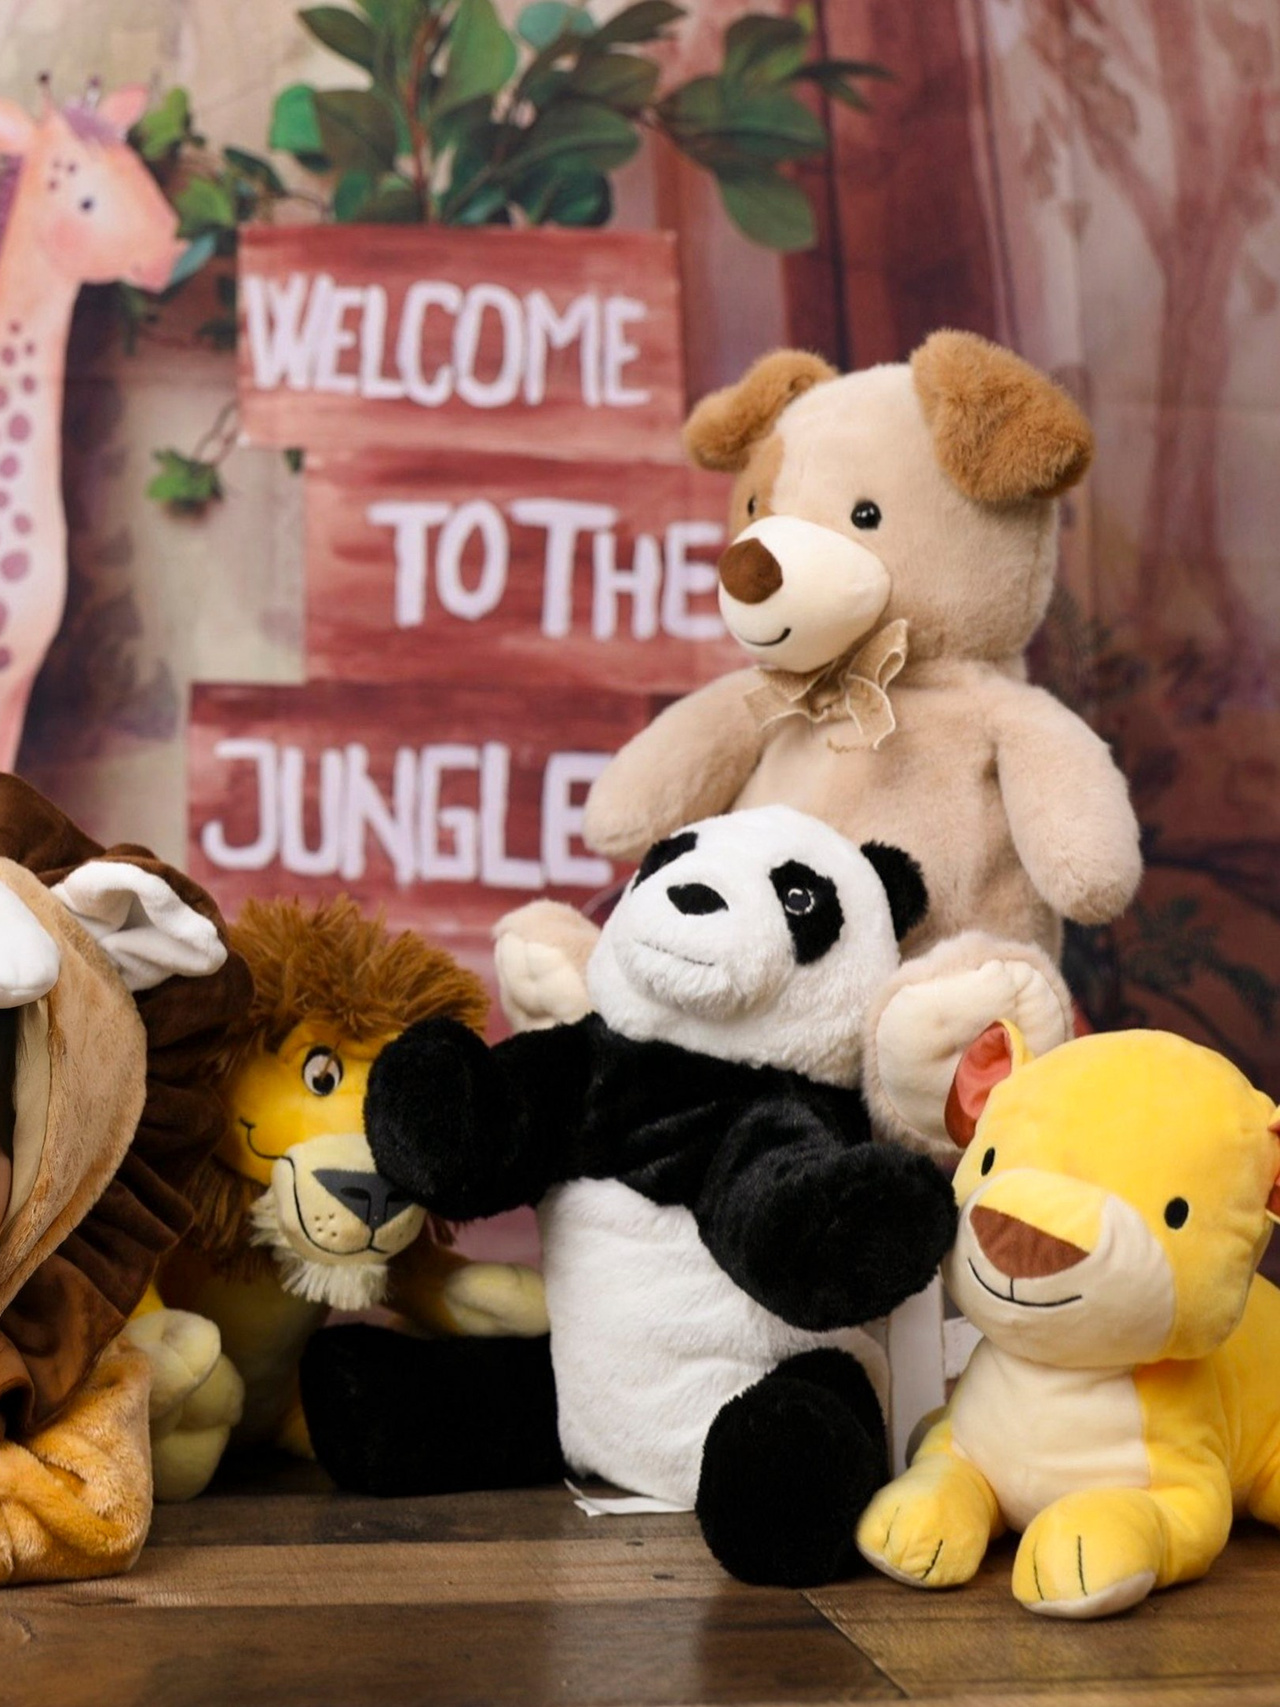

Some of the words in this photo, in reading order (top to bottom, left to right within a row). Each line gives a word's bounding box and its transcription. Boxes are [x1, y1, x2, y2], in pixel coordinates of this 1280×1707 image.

[242, 272, 651, 408] WELCOME
[366, 499, 510, 628] TO
[509, 497, 724, 641] THE
[201, 739, 614, 889] JUNGLE
